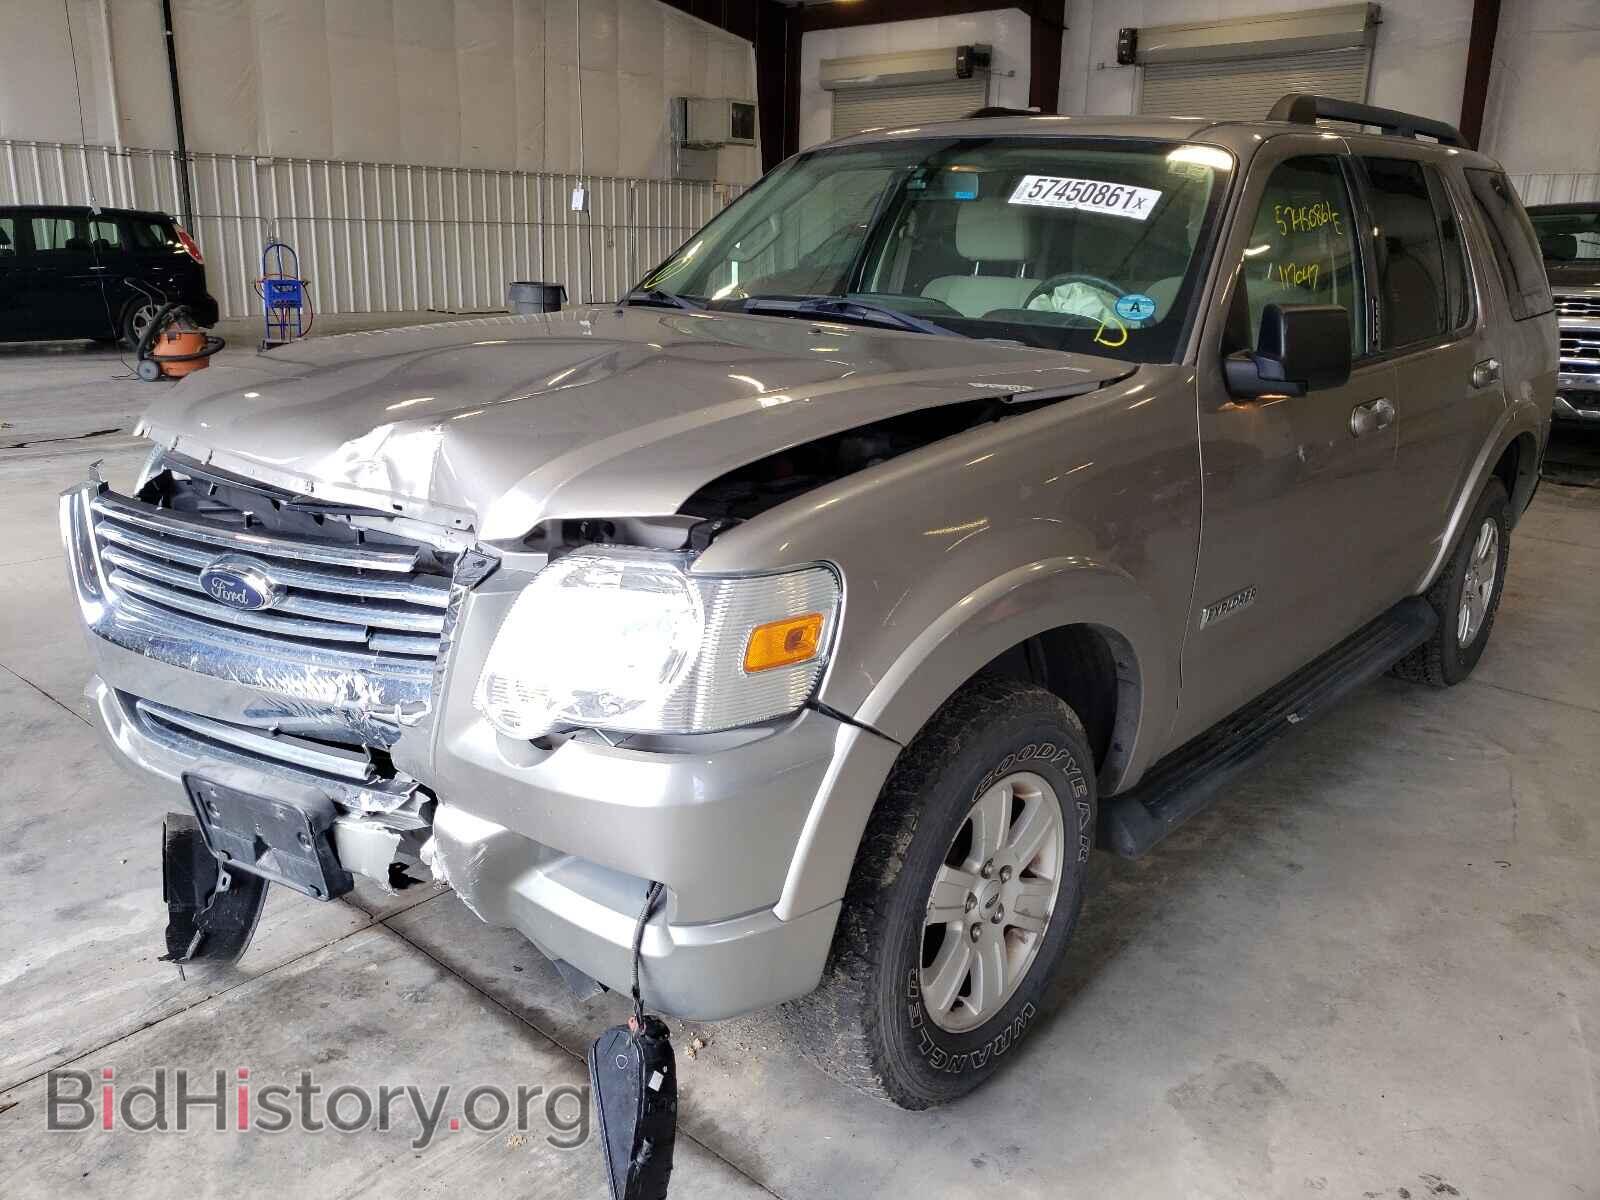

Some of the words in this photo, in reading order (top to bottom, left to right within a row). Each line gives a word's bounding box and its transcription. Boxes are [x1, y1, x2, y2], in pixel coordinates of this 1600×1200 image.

[1130, 302, 1141, 313] A
[211, 577, 249, 605] Ford
[972, 742, 1091, 863] GOODYEAR
[907, 967, 1037, 1073] WRANGLER
